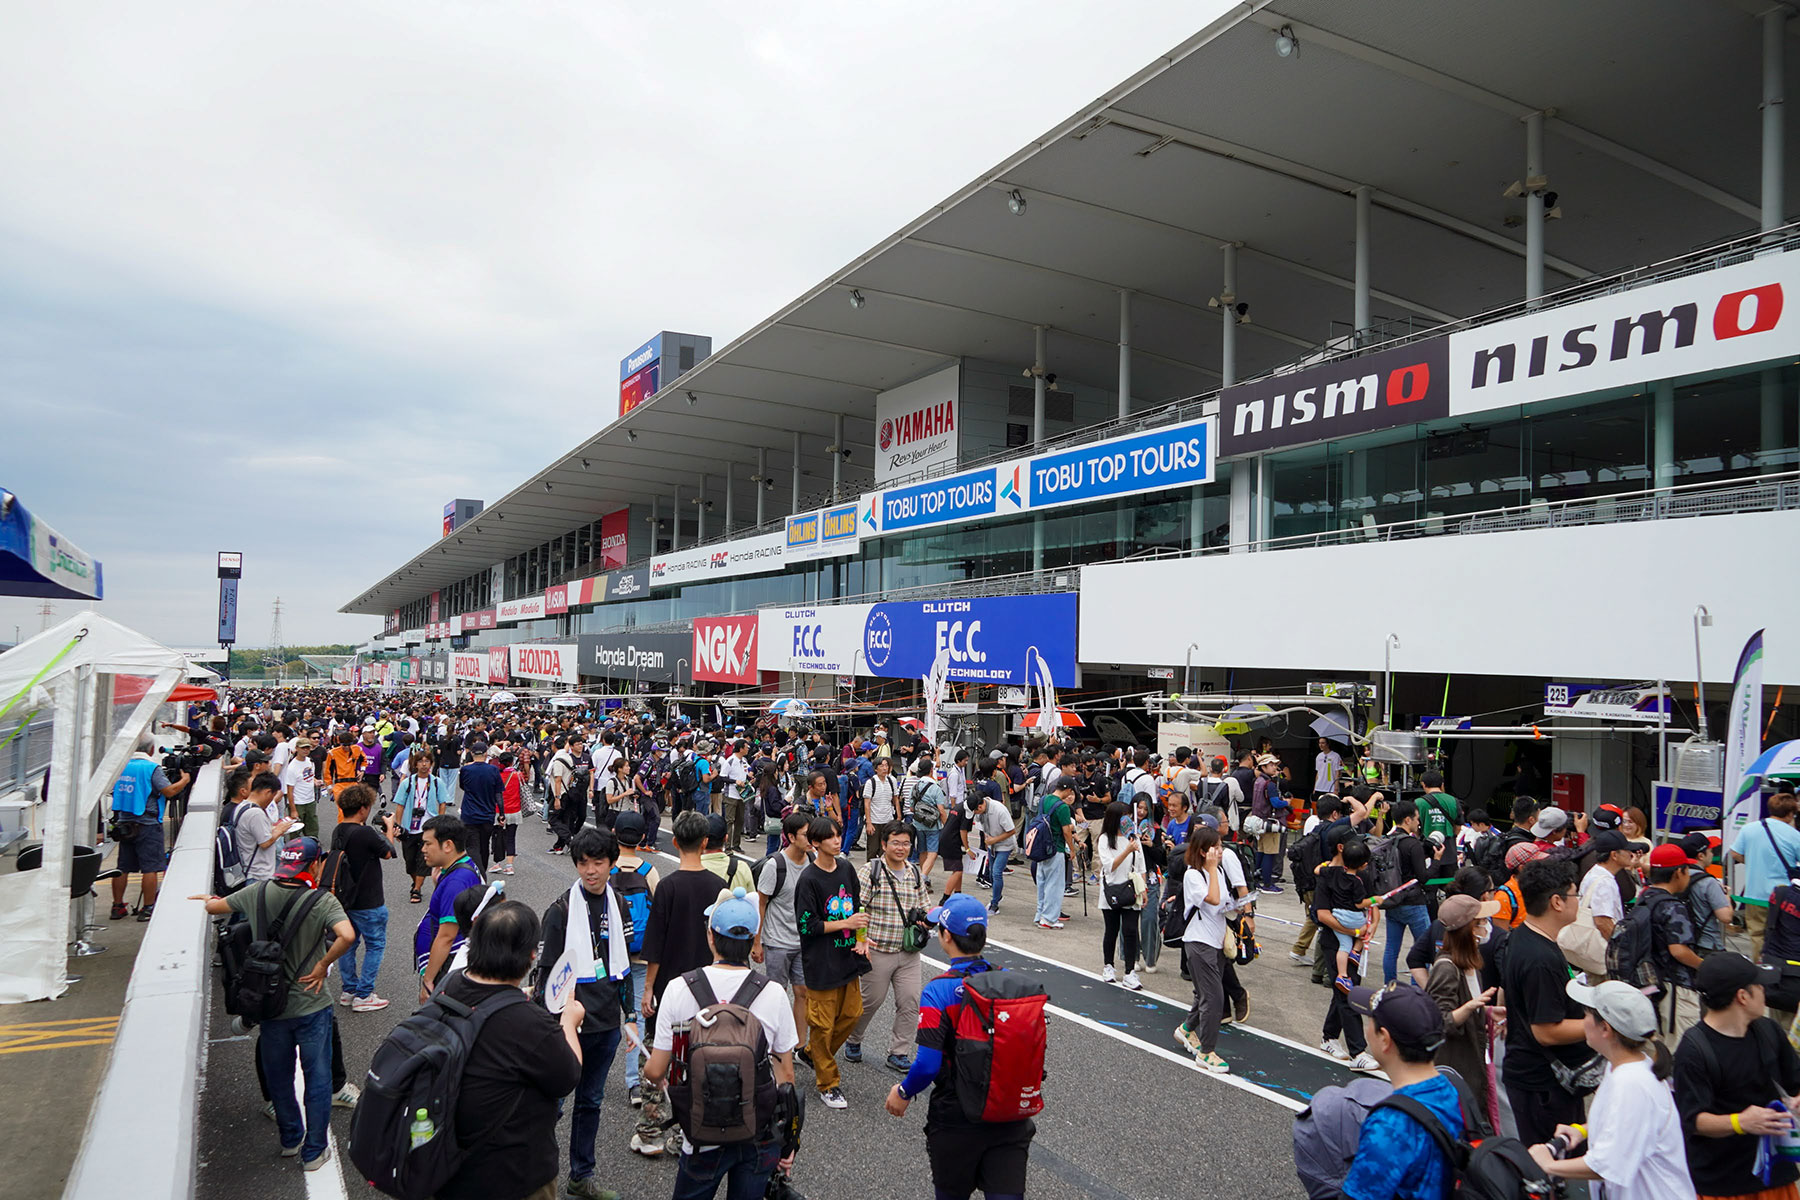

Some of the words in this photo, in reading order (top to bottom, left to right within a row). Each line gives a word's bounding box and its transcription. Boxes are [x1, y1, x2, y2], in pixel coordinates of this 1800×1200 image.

[1471, 283, 1784, 390] nismo
[627, 345, 653, 374] Panasonic
[1233, 363, 1430, 436] nismo
[895, 400, 954, 446] YAMAHA
[889, 452, 912, 471] Revs
[911, 447, 929, 464] Your
[927, 439, 948, 454] Heart
[1036, 460, 1082, 494] TOBU
[1087, 452, 1126, 485] TOP
[1131, 438, 1200, 477] TOURS
[887, 493, 917, 521] TOBU
[920, 488, 945, 515] TOP
[947, 480, 993, 512] TOURS
[788, 521, 817, 543] ÖHLINS
[824, 513, 856, 537] ÖHLINS
[602, 533, 626, 549] HONDA
[730, 551, 753, 562] Honda
[754, 546, 782, 559] RACING
[667, 562, 685, 572] Honda
[686, 559, 707, 570] RACING
[501, 605, 517, 616] Modulo
[521, 603, 540, 614] Modulo
[785, 610, 815, 618] CLUTCH
[923, 602, 970, 613] CLUTCH
[695, 624, 742, 674] NGK
[793, 625, 825, 657] F.C.C.
[936, 620, 986, 663] F.C.C.
[455, 656, 480, 677] HONDA
[489, 650, 506, 679] NGK
[519, 649, 562, 676] HONDA
[595, 646, 624, 666] Honda
[628, 646, 663, 669] Dream
[798, 662, 840, 671] TECHNOLOGY
[947, 668, 1012, 679] TECHNOLOGY
[1000, 687, 1008, 699] 98
[1325, 682, 1337, 697] 21
[1549, 688, 1566, 702] 225
[1586, 689, 1640, 706] KTMS
[1664, 802, 1720, 820] KTMS
